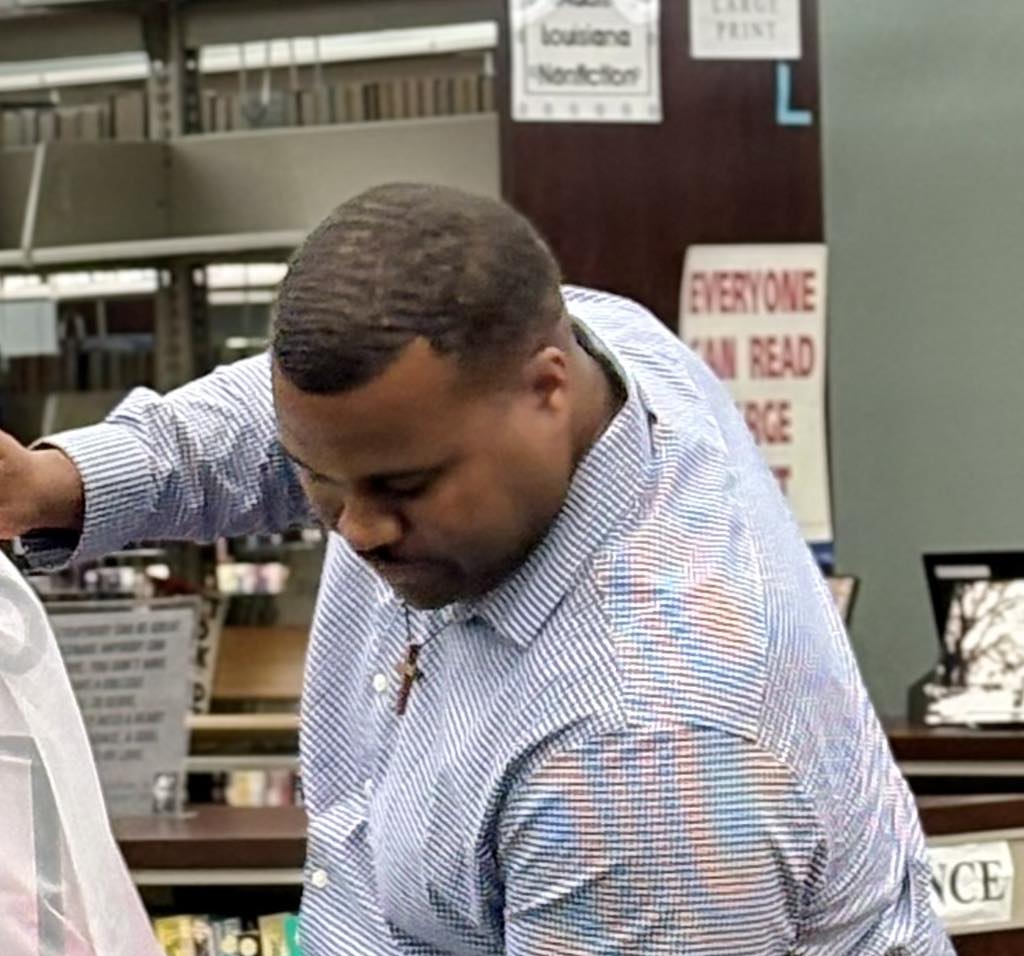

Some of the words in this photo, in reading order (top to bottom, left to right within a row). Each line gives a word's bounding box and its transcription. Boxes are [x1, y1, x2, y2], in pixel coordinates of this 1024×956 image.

[716, 22, 776, 42] PRINT
[777, 63, 812, 125] L
[690, 270, 816, 315] EVERYONE
[690, 335, 737, 380] AN
[748, 334, 815, 379] READ
[735, 401, 791, 445] RGE
